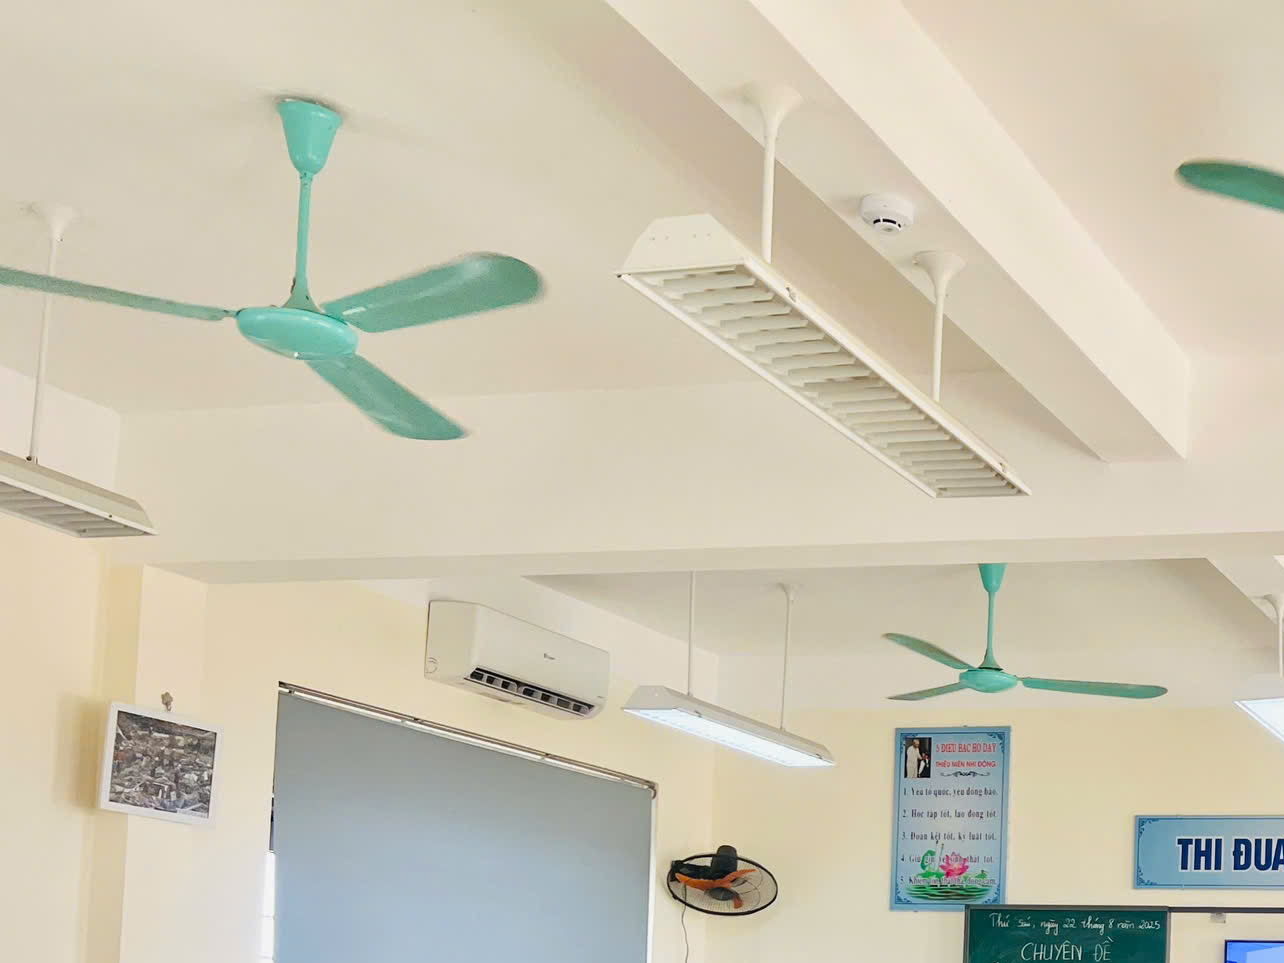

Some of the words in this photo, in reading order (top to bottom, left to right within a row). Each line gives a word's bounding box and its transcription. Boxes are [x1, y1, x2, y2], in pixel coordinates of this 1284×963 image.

[1177, 838, 1222, 870] THI
[1062, 918, 1077, 929] 22
[1108, 918, 1115, 929] 8
[1138, 919, 1161, 930] 2025
[1021, 940, 1082, 961] CHUYÊN
[1092, 936, 1114, 962] ĐỀ
